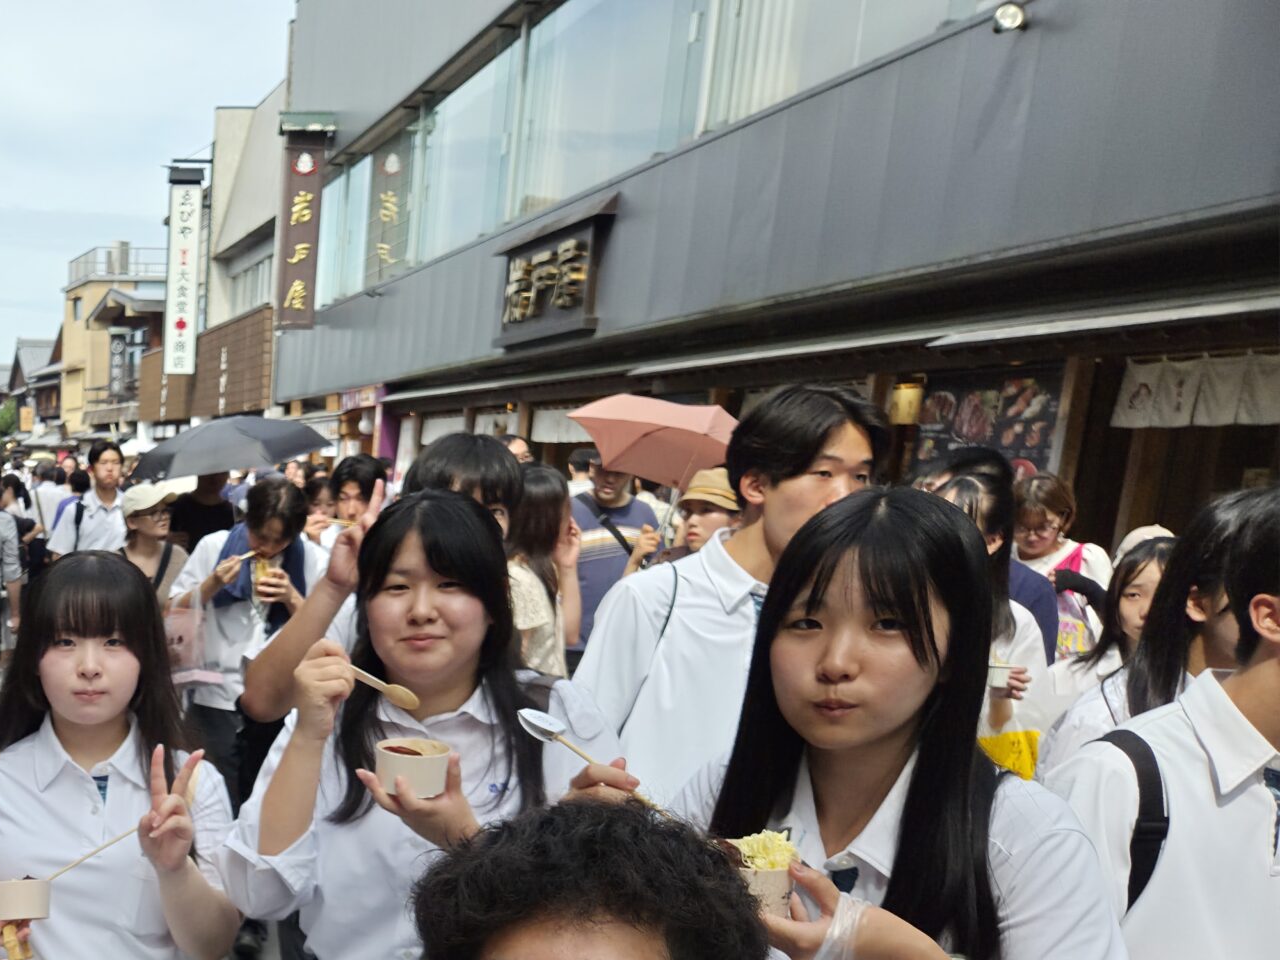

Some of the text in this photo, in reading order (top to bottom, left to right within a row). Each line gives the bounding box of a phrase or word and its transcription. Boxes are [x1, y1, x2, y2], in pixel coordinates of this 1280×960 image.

[173, 190, 194, 369] ゑびや 大食堂 商店
